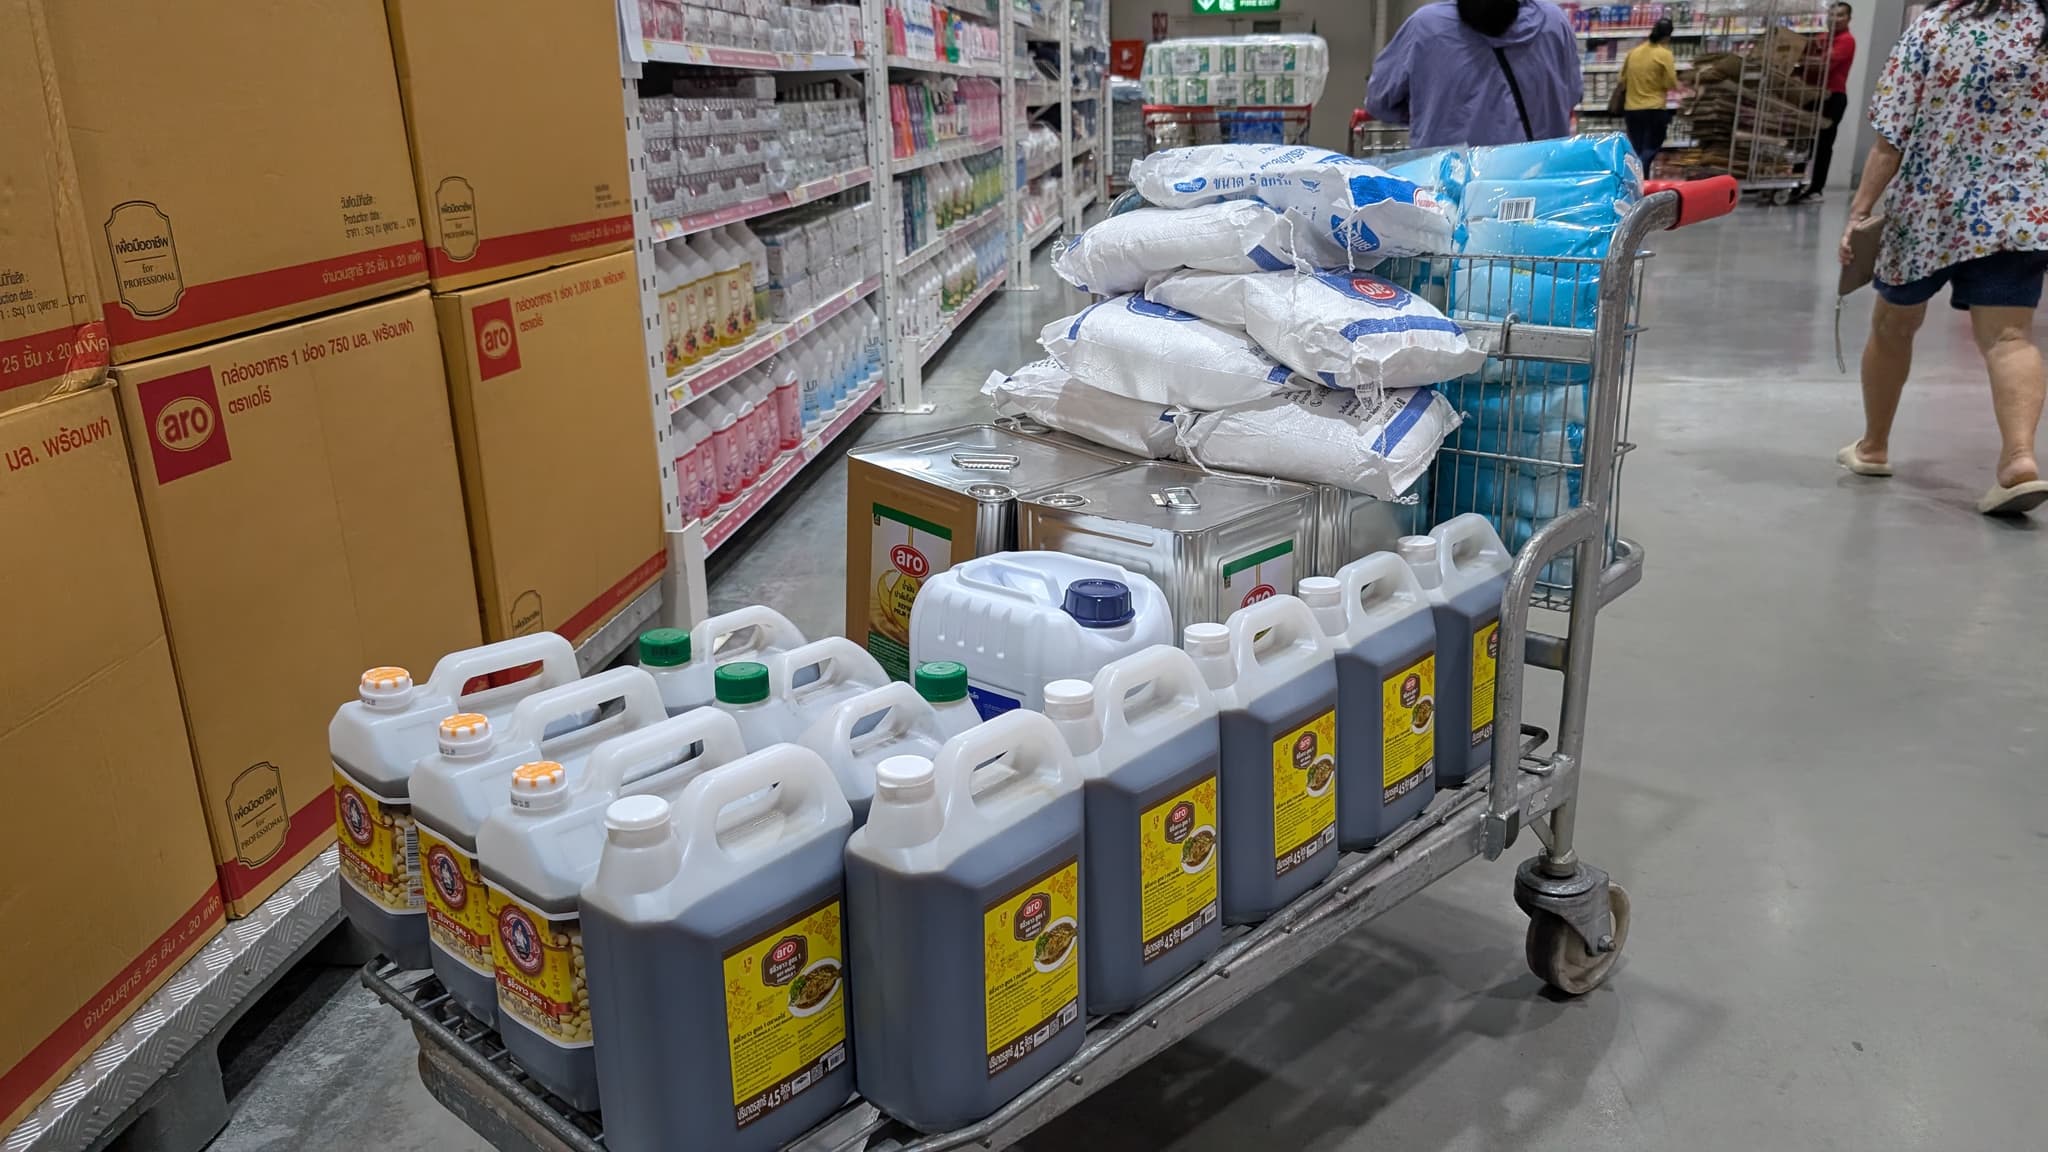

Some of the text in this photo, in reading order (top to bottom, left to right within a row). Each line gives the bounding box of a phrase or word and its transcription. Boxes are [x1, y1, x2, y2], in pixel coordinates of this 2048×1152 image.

[1213, 176, 1244, 190] ขนาด
[115, 236, 169, 255] เพื่อมืออาชีพ
[142, 263, 154, 274] for
[123, 272, 176, 289] PROFESSIONAL
[484, 327, 509, 351] aro
[2, 355, 20, 374] 25
[24, 344, 42, 369] ชิ้น
[46, 350, 54, 364] x
[57, 342, 72, 360] 20
[221, 354, 289, 386] กล่องอาหาร
[292, 351, 299, 366] 1
[302, 344, 326, 363] ช่อง
[328, 336, 350, 356] 750
[352, 333, 371, 349] มล.
[228, 385, 272, 415] ตราเอโร่
[163, 406, 208, 443] aro
[5, 446, 39, 471] มล.
[896, 550, 923, 572] aro
[241, 815, 284, 850] PROFESSIONAL
[1026, 901, 1040, 915] aro
[777, 944, 794, 959] aro
[83, 968, 142, 1029] จำนวนสุทธิ
[144, 953, 158, 974] 25
[160, 938, 176, 959] ชิ้น
[187, 915, 201, 934] 20
[768, 1089, 781, 1109] 4.5
